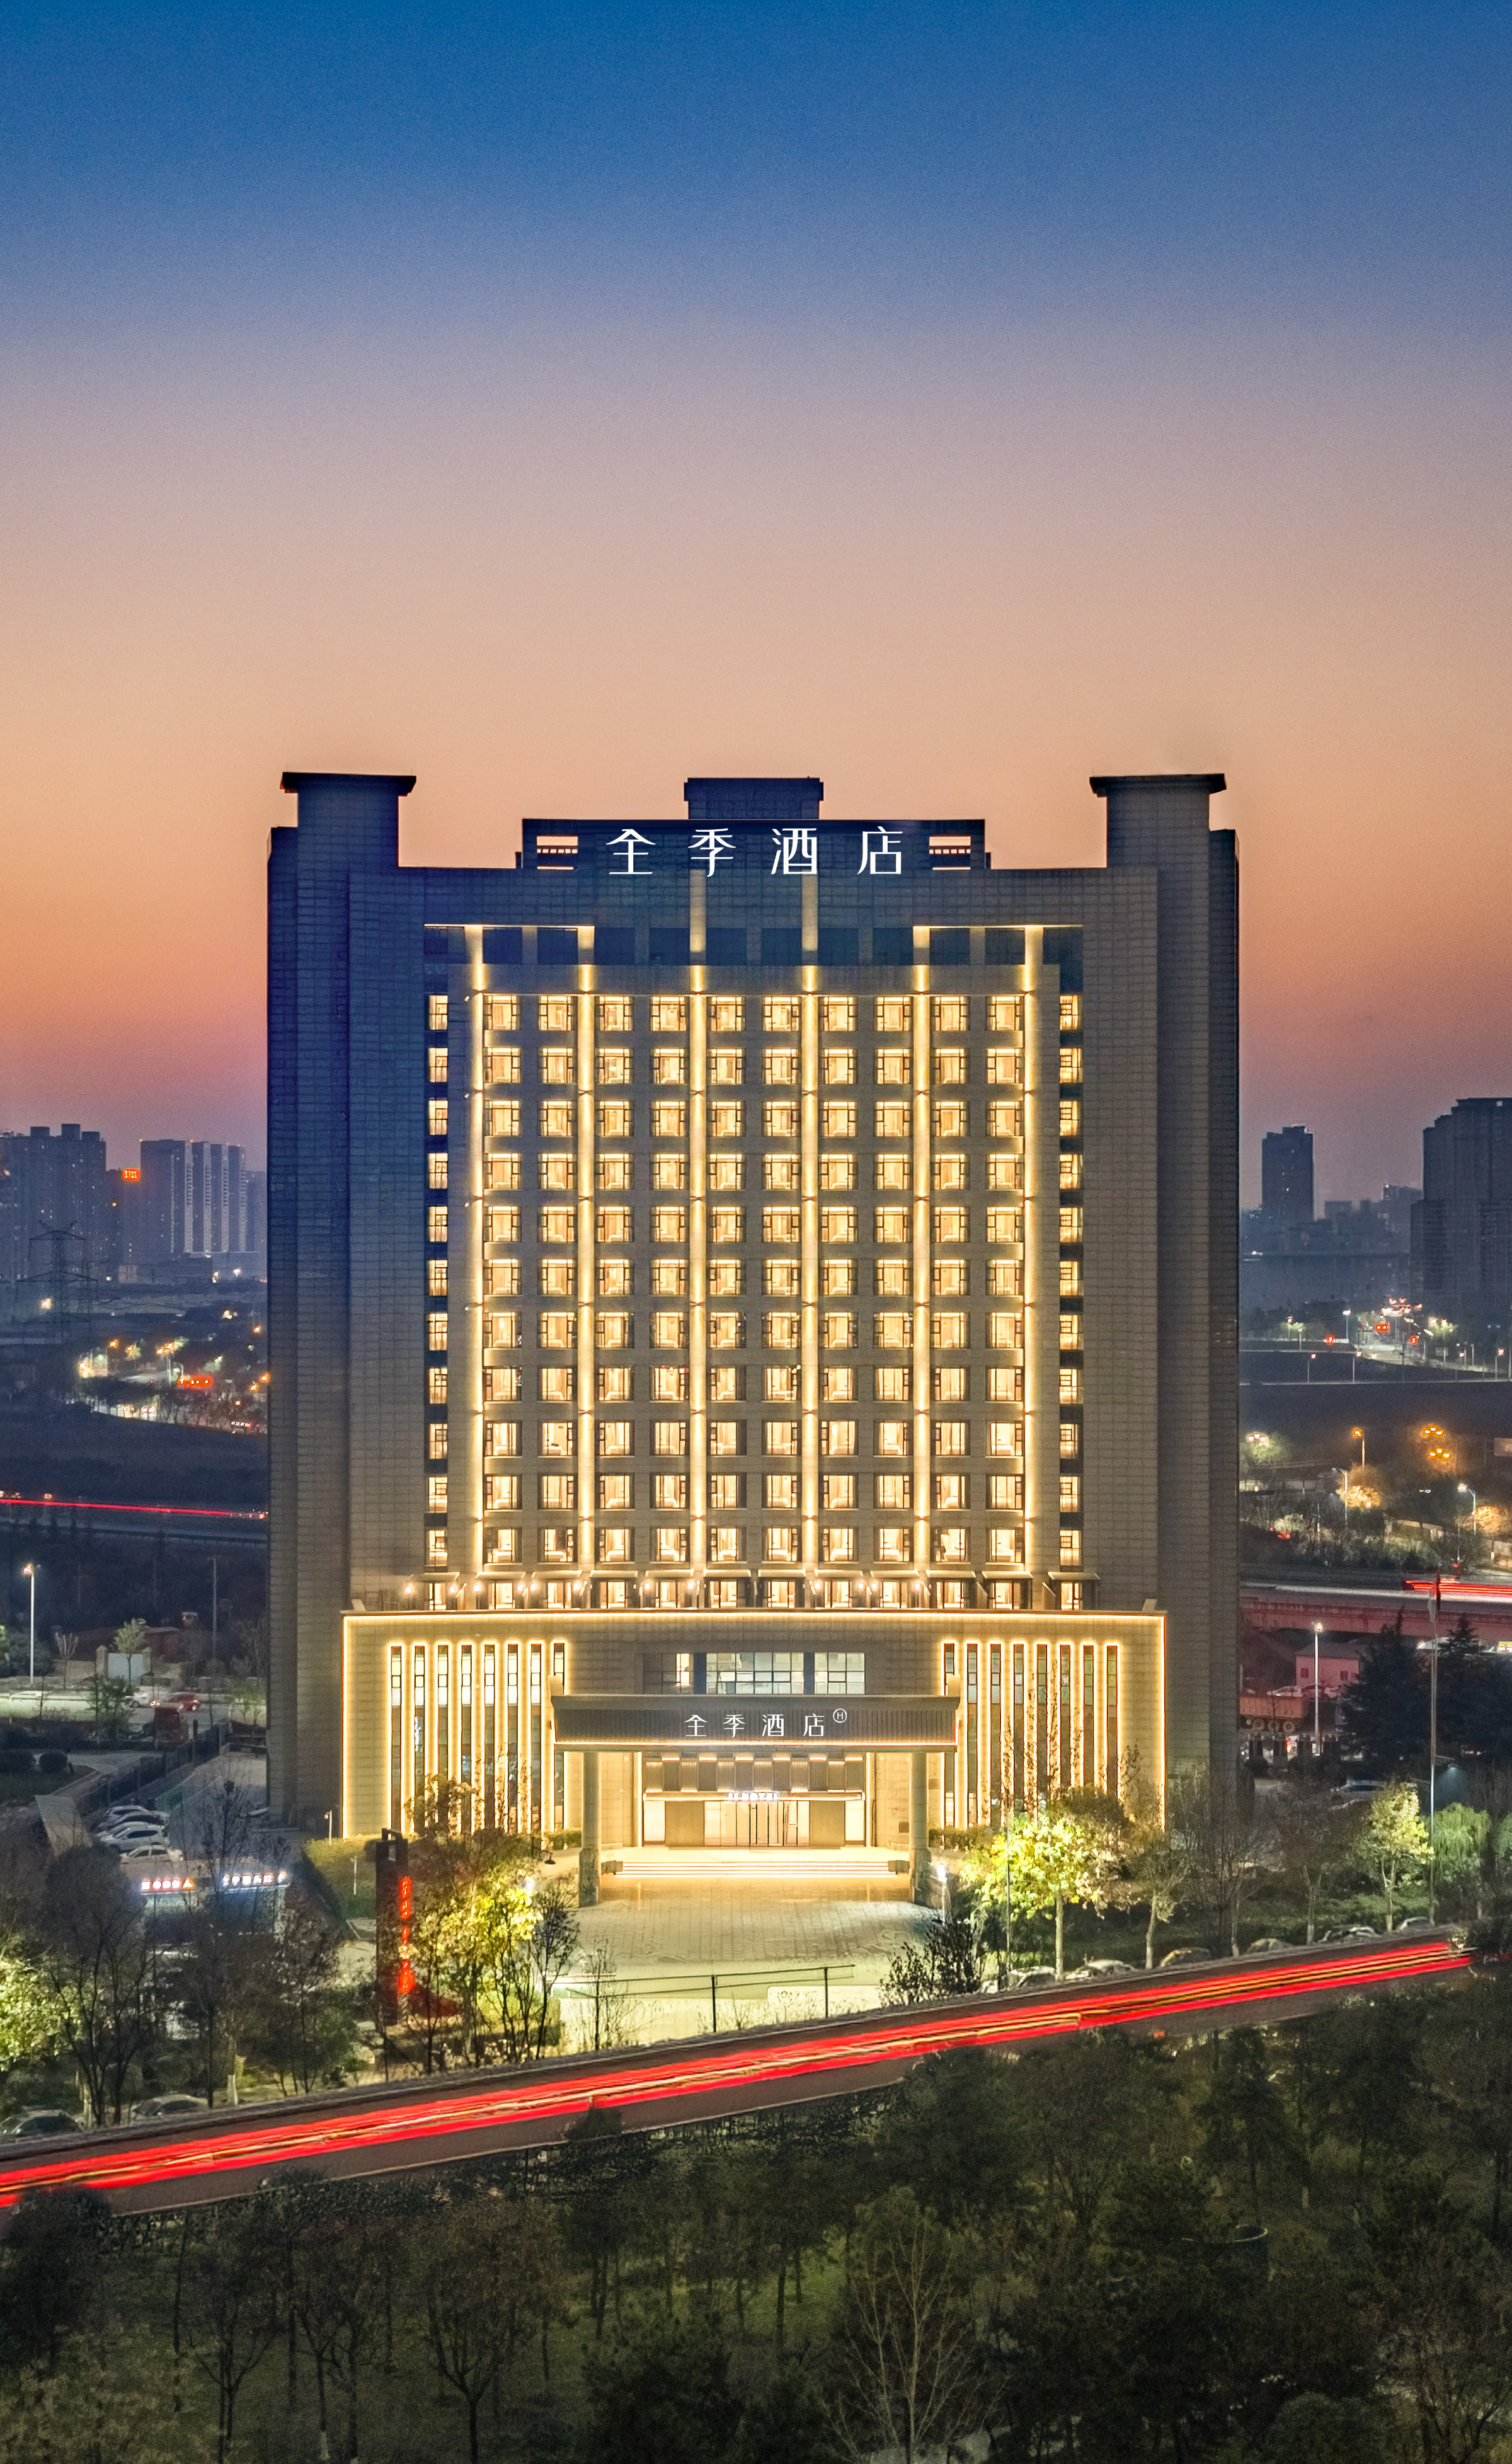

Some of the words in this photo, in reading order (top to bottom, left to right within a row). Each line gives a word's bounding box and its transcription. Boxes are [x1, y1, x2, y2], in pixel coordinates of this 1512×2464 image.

[605, 826, 903, 877] 全季酒店
[684, 1713, 825, 1738] 全季酒店
[742, 1792, 780, 1801] HOTEL
